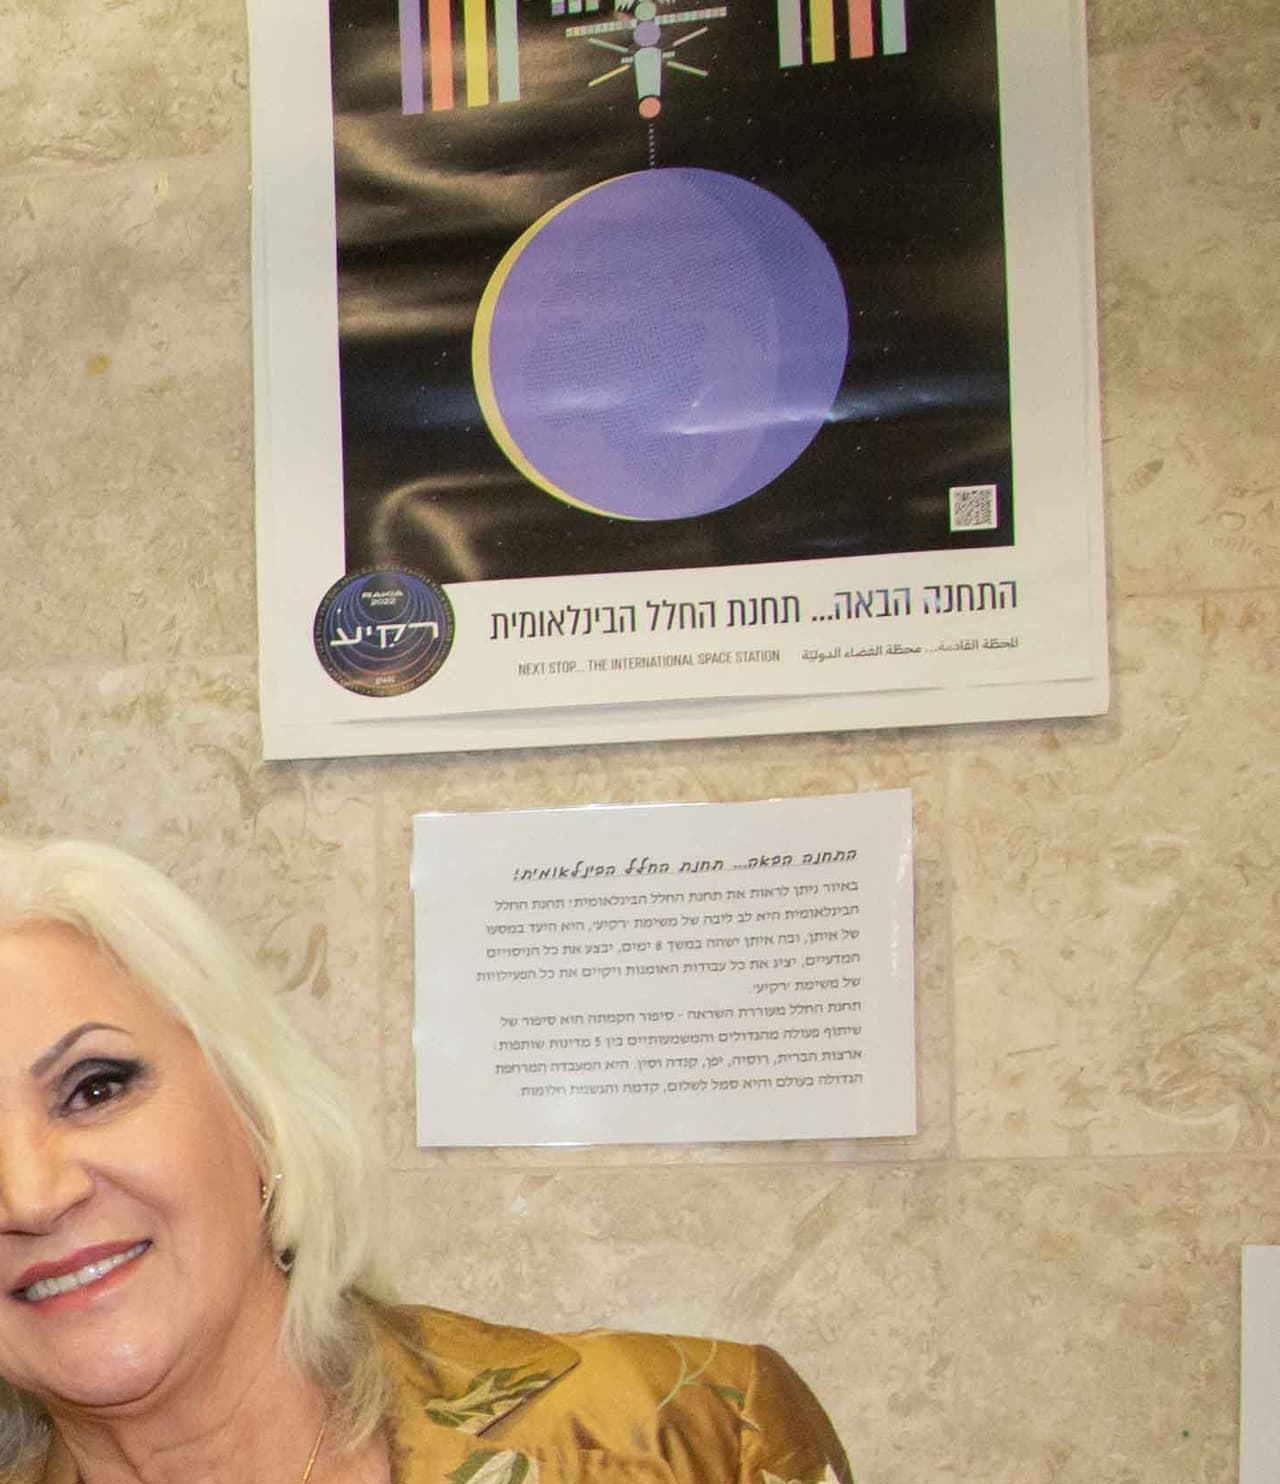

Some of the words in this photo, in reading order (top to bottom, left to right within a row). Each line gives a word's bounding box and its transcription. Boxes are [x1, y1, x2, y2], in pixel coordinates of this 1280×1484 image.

[923, 580, 1017, 614] התחנה
[812, 587, 911, 622] הבאה...
[646, 599, 716, 631] החלל
[726, 594, 800, 628] תחנת
[490, 604, 636, 640] הבינלאומית
[518, 661, 545, 677] NEXT
[589, 659, 608, 673] THE
[611, 652, 695, 671] INTERNATIONAL
[697, 651, 732, 666] SPACE
[735, 649, 780, 664] STATION
[802, 850, 857, 866] התחנה
[624, 857, 670, 875] החלל
[679, 858, 724, 873] תחנת
[749, 885, 790, 899] לראות
[793, 884, 819, 898] ניתן
[823, 880, 859, 893] באיור
[649, 891, 685, 904] החלל
[688, 890, 723, 902] תחנת
[726, 889, 746, 900] את
[495, 899, 528, 912] החלל
[531, 898, 565, 910] תחנת
[737, 911, 752, 923] לב
[756, 910, 781, 922] היא
[785, 904, 859, 919] הבינלאומית
[634, 917, 678, 929] משימת
[681, 914, 700, 926] של
[703, 912, 733, 925] ליבה
[561, 921, 585, 933] היא
[840, 928, 860, 940] של
[655, 940, 663, 951] 8
[667, 939, 702, 953] במשך
[744, 935, 774, 948] איתן
[543, 943, 559, 956] כל
[562, 944, 582, 955] את
[683, 961, 726, 973] עבודות
[729, 959, 745, 970] כל
[749, 959, 769, 970] את
[539, 967, 555, 980] כל
[559, 968, 578, 979] את
[795, 978, 839, 991] משימת
[842, 977, 861, 988] של
[790, 1003, 823, 1015] החלל
[827, 1001, 861, 1013] תחנת
[560, 1014, 583, 1025] הוא
[640, 1011, 674, 1023] סיפור
[688, 1008, 733, 1020] השראה
[500, 1016, 518, 1028] של
[522, 1016, 556, 1027] סיפור
[605, 1036, 623, 1050] בין
[666, 1056, 698, 1069] קנדה
[821, 1050, 862, 1063] ארצות
[605, 1059, 630, 1071] היא
[711, 1078, 739, 1091] סמל
[743, 1077, 772, 1089] והיא
